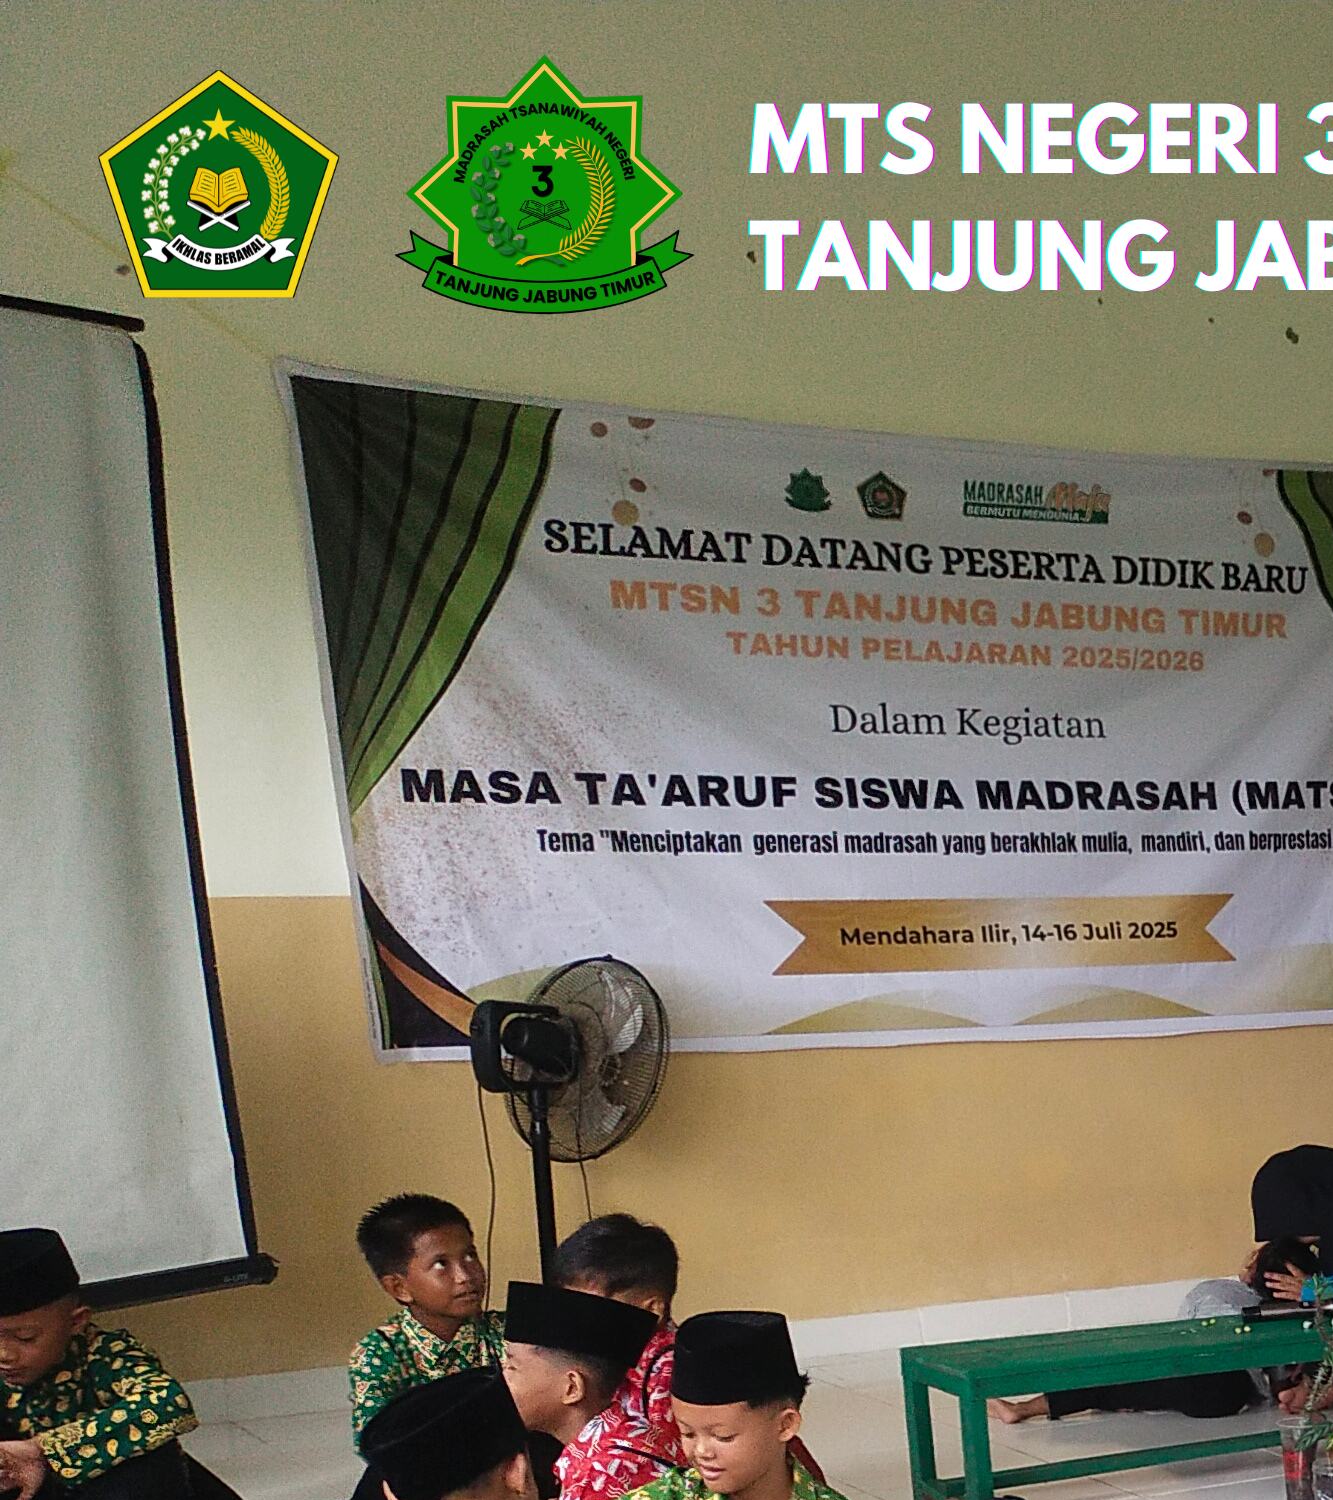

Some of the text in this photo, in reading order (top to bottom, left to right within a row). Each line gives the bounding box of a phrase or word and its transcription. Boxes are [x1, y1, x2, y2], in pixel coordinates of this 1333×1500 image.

[963, 480, 1044, 506] MADRASAH
[966, 505, 1080, 522] BERMUTU MENDUNIA
[543, 518, 1309, 595] SELAMAT DATANG PESERTA DIDIK BARU
[608, 579, 1288, 639] MTSN 3 TANJUNG JABUNG TIMUR
[726, 630, 1205, 673] TAHUN PELAJARAN 2025/2026
[829, 702, 1107, 746] Dalam Kegiatan
[400, 768, 562, 805] MASA
[575, 771, 798, 809] TA'ARUF
[814, 776, 963, 810] SISWA
[976, 778, 1219, 811] MADRASAH
[536, 827, 595, 854] Tema
[600, 828, 743, 857] "Menciptakan
[753, 830, 839, 857] generasi
[843, 829, 938, 855] madrasah
[942, 832, 987, 857] yang
[991, 829, 1078, 855] berakhlak
[1081, 829, 1134, 856] mulia,
[1140, 829, 1212, 856] mandiri,
[1214, 829, 1246, 852] dan
[1248, 827, 1333, 854] berprestasi
[840, 920, 1180, 947] Mendahara Ilir, 14-16 Juli 2025
